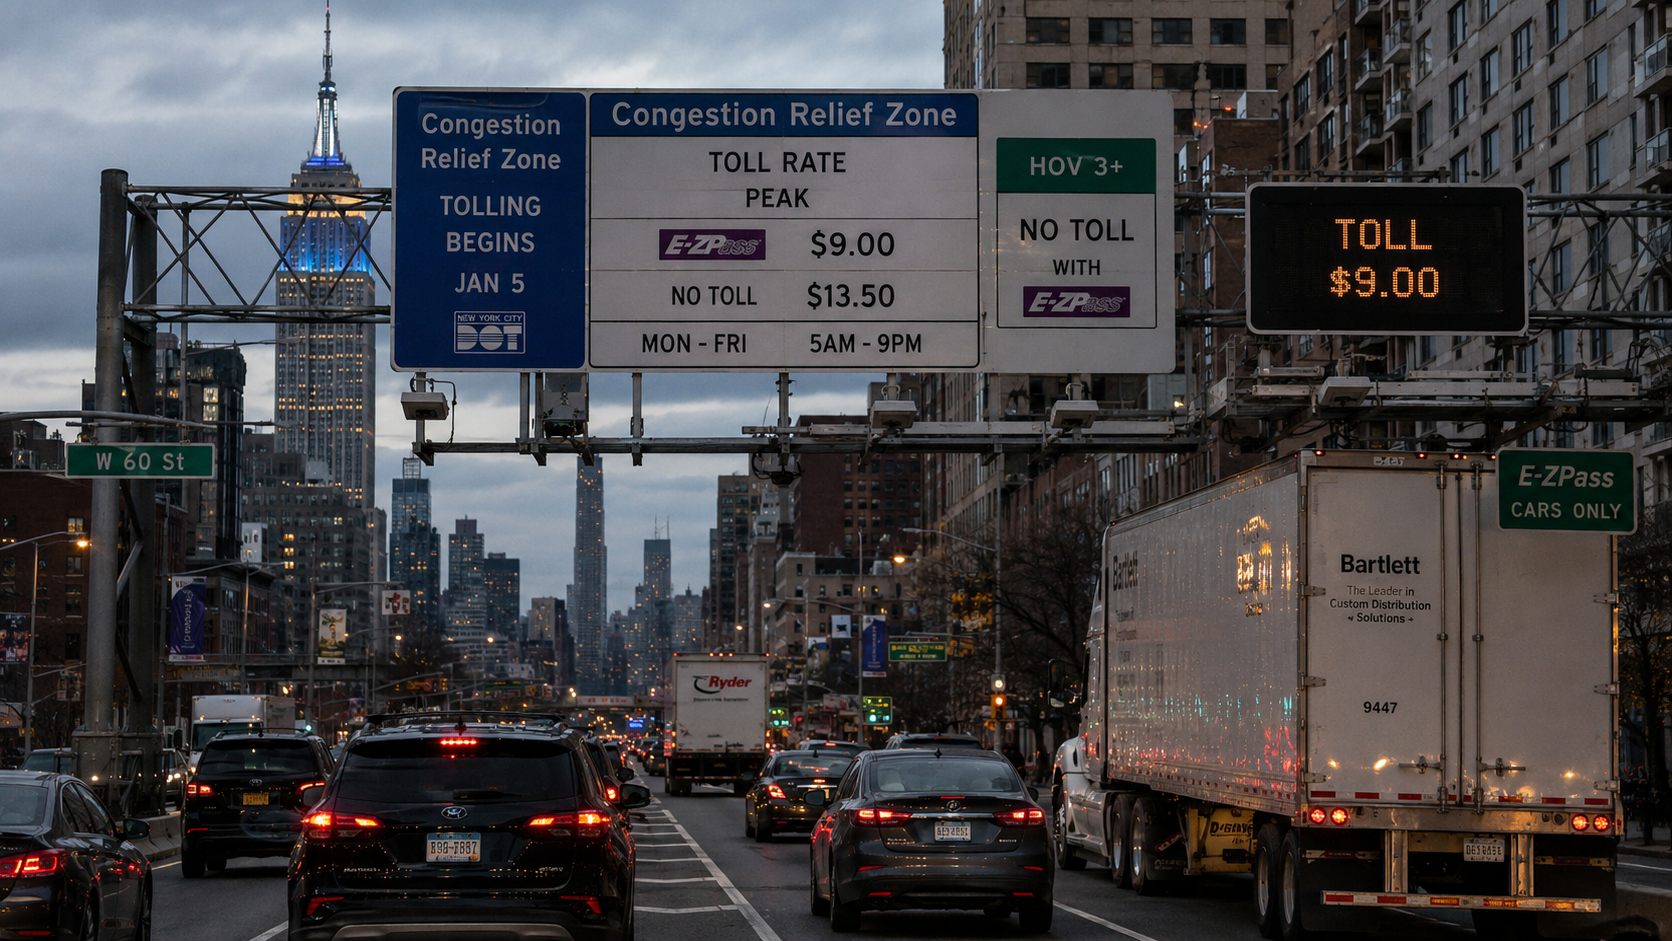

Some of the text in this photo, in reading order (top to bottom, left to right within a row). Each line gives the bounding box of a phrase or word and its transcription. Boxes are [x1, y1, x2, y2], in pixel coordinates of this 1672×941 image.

[422, 113, 561, 140] Congestion
[612, 102, 957, 132] Congestion Relief Zone
[421, 148, 561, 169] Relief Zone
[709, 152, 847, 173] TOLL RATE
[1030, 156, 1124, 176] HOV 3+
[440, 195, 541, 216] TOLLING
[746, 188, 810, 208] PEAK
[1020, 218, 1135, 241] NO TOLL
[1334, 218, 1433, 250] TOLL
[446, 232, 535, 252] BEGINS
[665, 230, 895, 259] E-ZPass $9.00
[1052, 259, 1101, 276] WITH
[455, 273, 525, 293] JAN 5
[1330, 265, 1440, 298] $9.00
[671, 282, 895, 310] NO TOLL $13.50
[1028, 291, 1126, 313] E-ZPass
[457, 314, 523, 322] NEW YORK CITY
[457, 325, 522, 350] DOT
[642, 333, 691, 353] MON
[714, 333, 746, 353] FRI
[810, 333, 855, 353] 5AM
[877, 333, 922, 353] 9PM
[96, 452, 185, 471] W 60 St
[1519, 465, 1615, 489] E-ZPass
[1511, 501, 1622, 519] CARS ONLY
[1341, 554, 1420, 575] Bartlett
[1347, 585, 1415, 597] The Leader in
[1329, 598, 1431, 611] Custom Distribution
[1356, 612, 1406, 624] Solutions
[709, 675, 752, 690] Ryder
[1363, 701, 1398, 714] 9447
